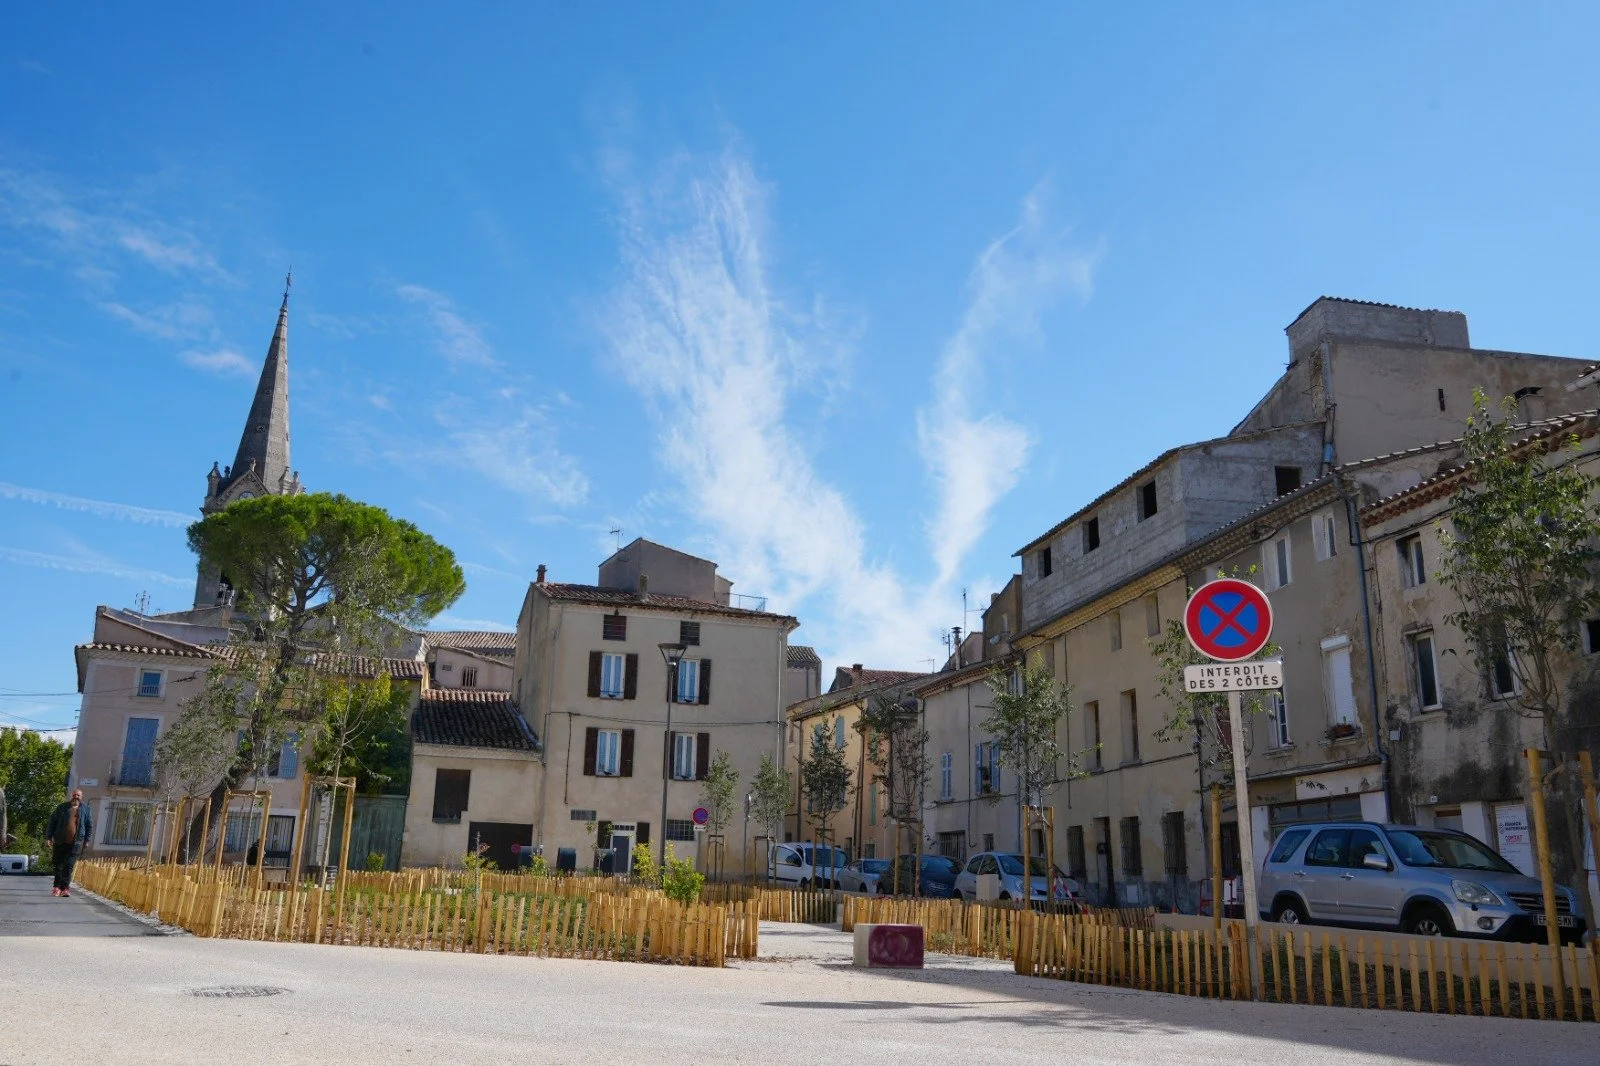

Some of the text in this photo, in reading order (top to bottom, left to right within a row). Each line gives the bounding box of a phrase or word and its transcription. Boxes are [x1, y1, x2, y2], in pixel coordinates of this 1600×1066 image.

[1200, 665, 1265, 677] INTERDIT
[1190, 674, 1279, 689] DES 2 CÔTÉS
